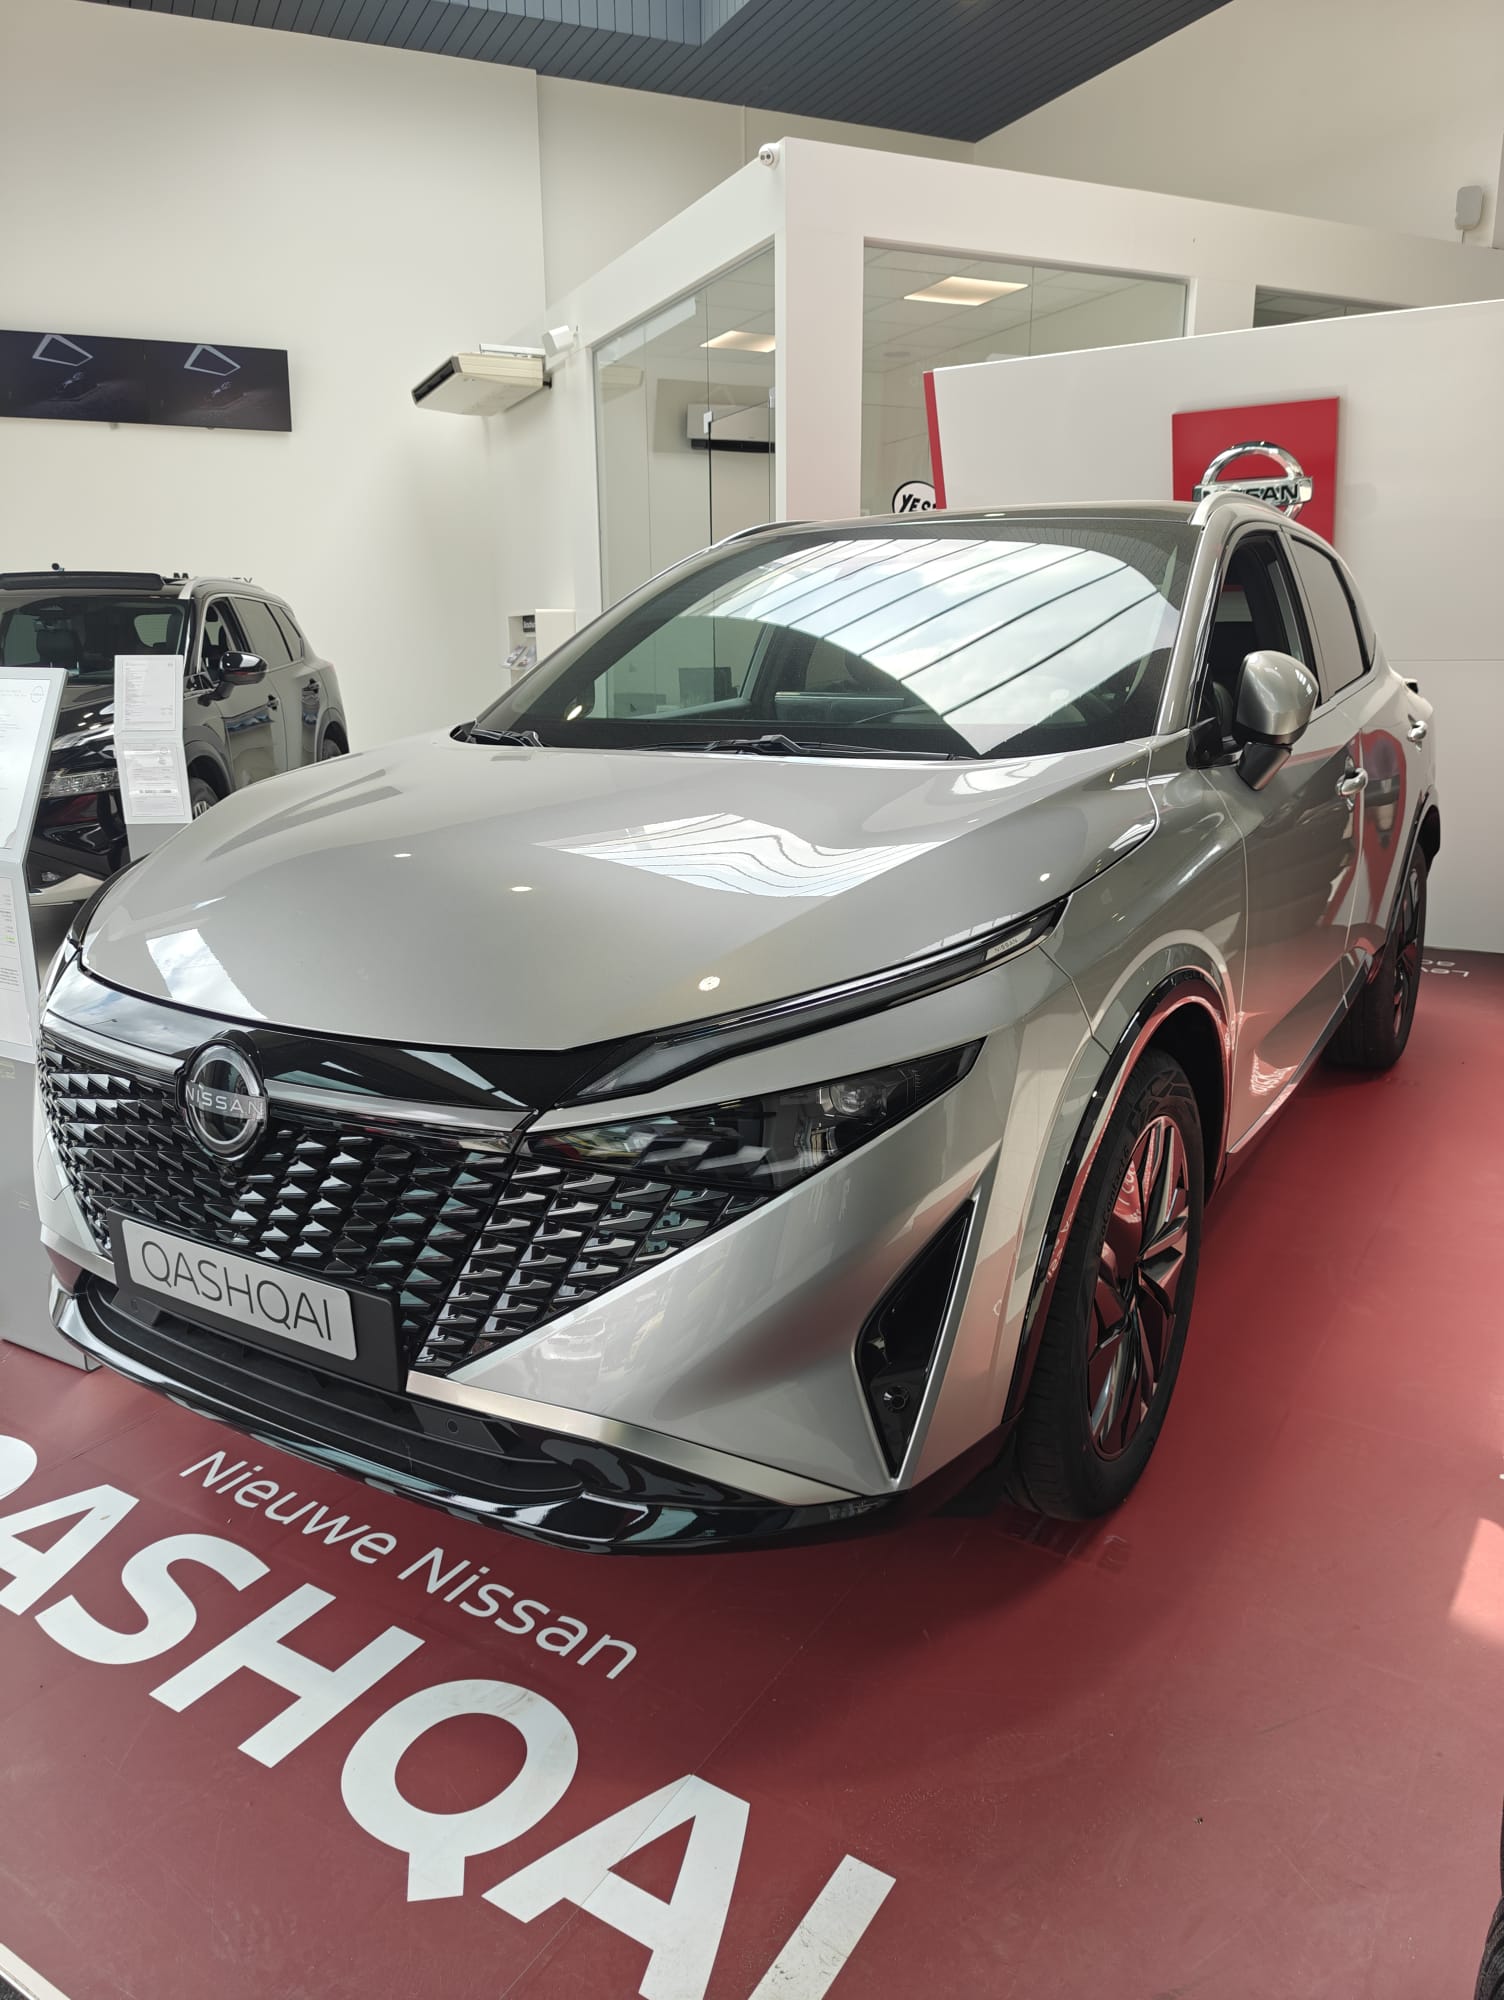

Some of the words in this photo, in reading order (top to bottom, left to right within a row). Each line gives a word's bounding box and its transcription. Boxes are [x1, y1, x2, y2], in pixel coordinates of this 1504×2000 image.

[1203, 484, 1298, 501] SAN
[185, 1084, 263, 1116] NISSAN
[141, 1239, 334, 1342] QASHQAI
[180, 1450, 398, 1565] Nieuwe
[397, 1546, 638, 1680] Nissan
[0, 1435, 897, 2000] ASHQAI
